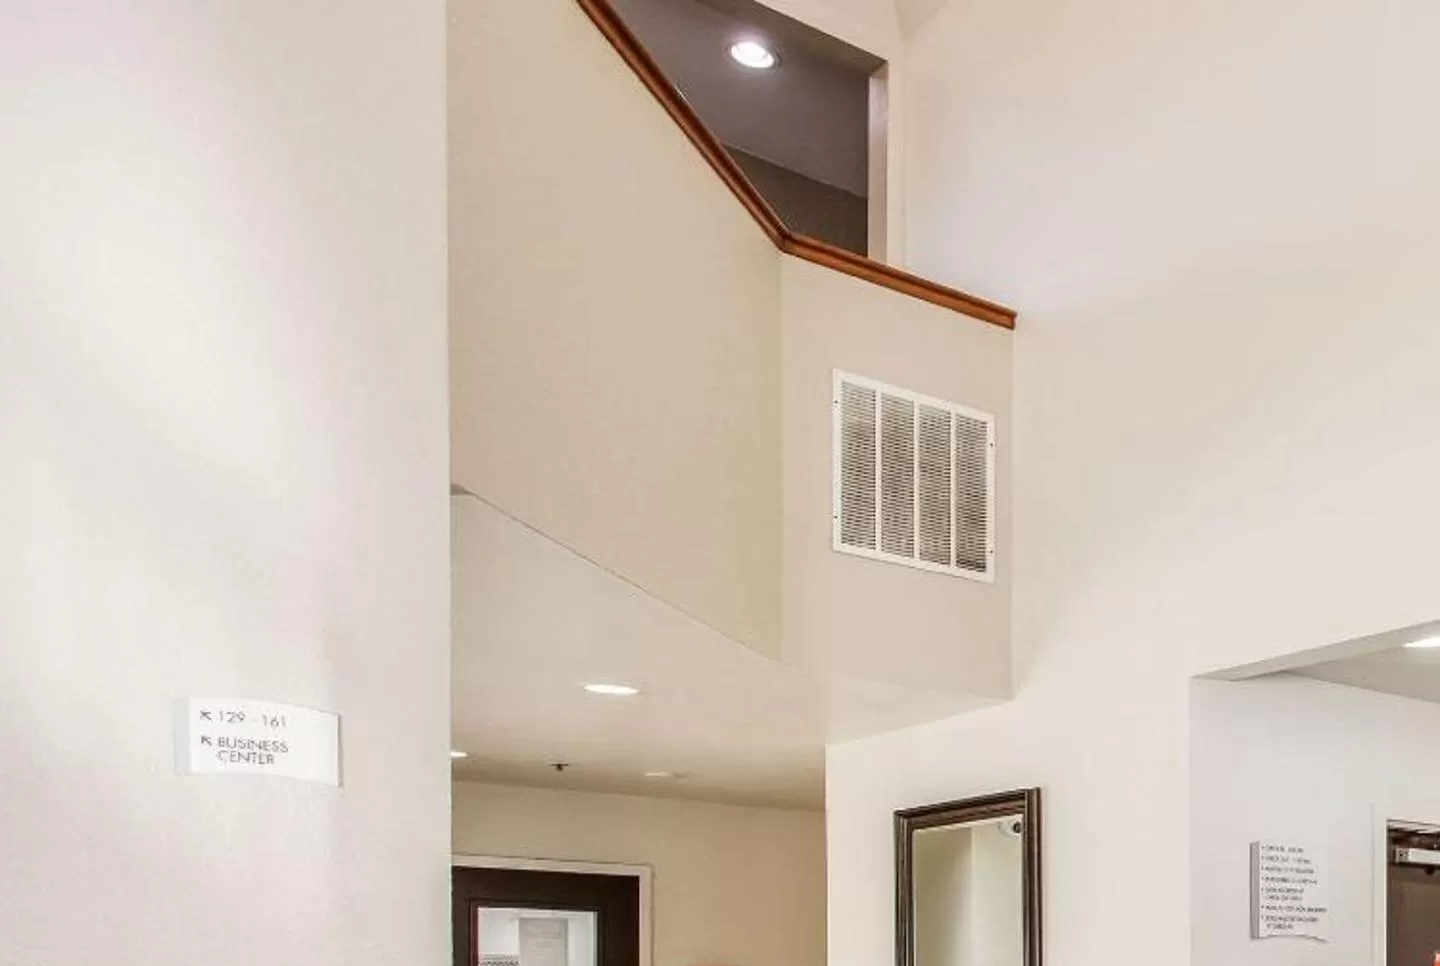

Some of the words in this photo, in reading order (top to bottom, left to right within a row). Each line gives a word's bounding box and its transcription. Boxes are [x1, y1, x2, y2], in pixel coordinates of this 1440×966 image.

[219, 710, 246, 723] 129
[262, 714, 286, 728] 161
[218, 736, 288, 753] BUSINESS
[217, 750, 275, 765] CENTER
